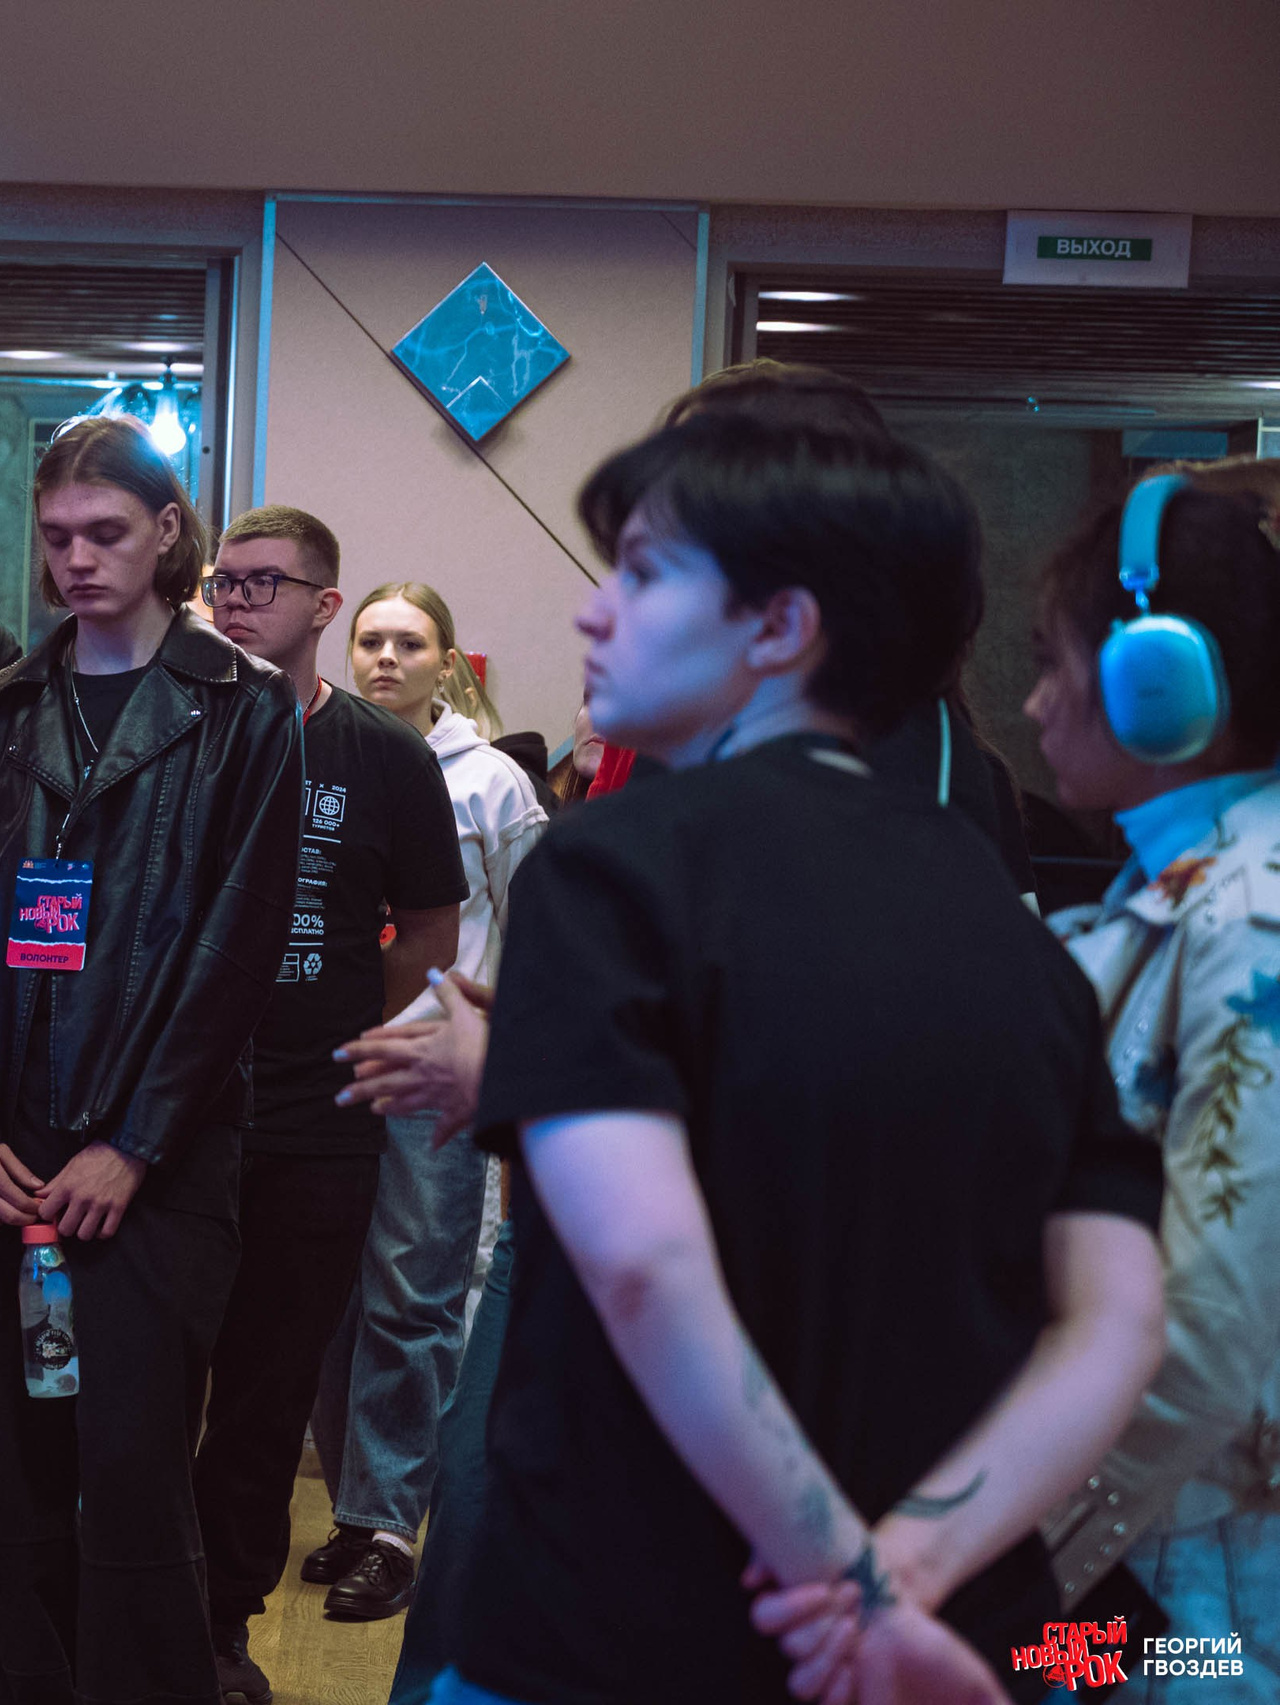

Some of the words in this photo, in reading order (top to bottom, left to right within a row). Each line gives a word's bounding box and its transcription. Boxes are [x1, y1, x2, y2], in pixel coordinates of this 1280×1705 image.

[1056, 238, 1132, 258] ВЫХОД
[332, 785, 346, 793] 2024
[37, 893, 83, 910] СТАРЫЙ
[46, 912, 80, 934] РОК
[20, 952, 69, 964] ВОЛОНТЕР
